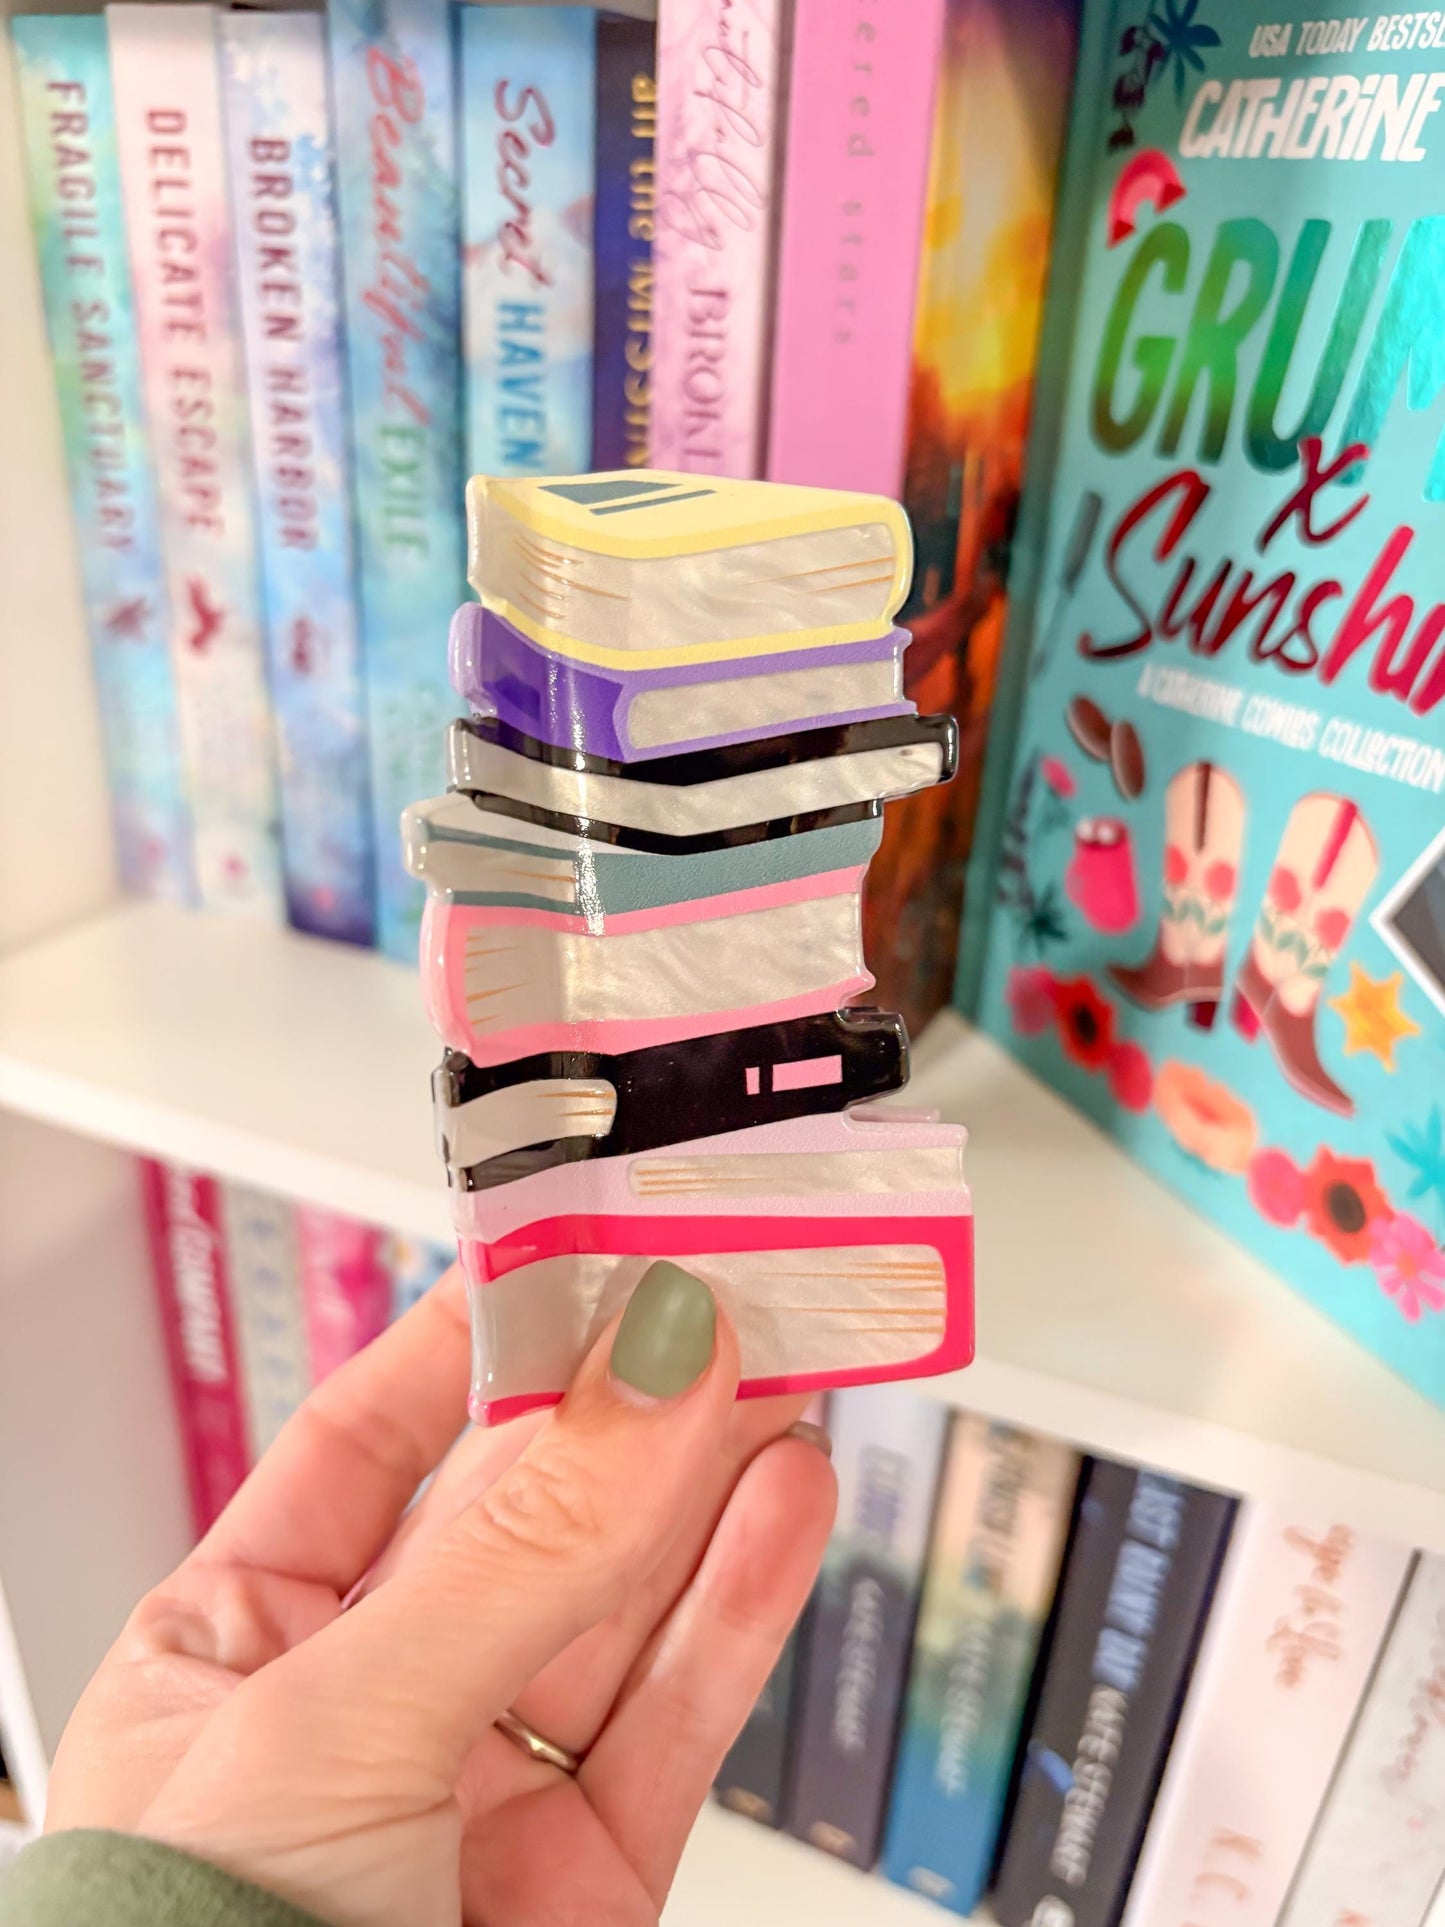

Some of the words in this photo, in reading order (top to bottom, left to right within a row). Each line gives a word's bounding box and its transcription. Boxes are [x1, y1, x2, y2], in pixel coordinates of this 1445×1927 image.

[1249, 23, 1288, 58] USA
[1296, 17, 1367, 55] TODAY
[46, 80, 104, 280] FRAGILE
[147, 108, 207, 345] DELICATE
[250, 137, 303, 342] BROKEN
[493, 78, 555, 288] Secret
[73, 302, 136, 552] SANCTUARY
[168, 367, 224, 538] ESCAPE
[268, 366, 320, 552] HARBOR
[494, 302, 546, 470] HAVEN
[378, 424, 430, 558] EXILE
